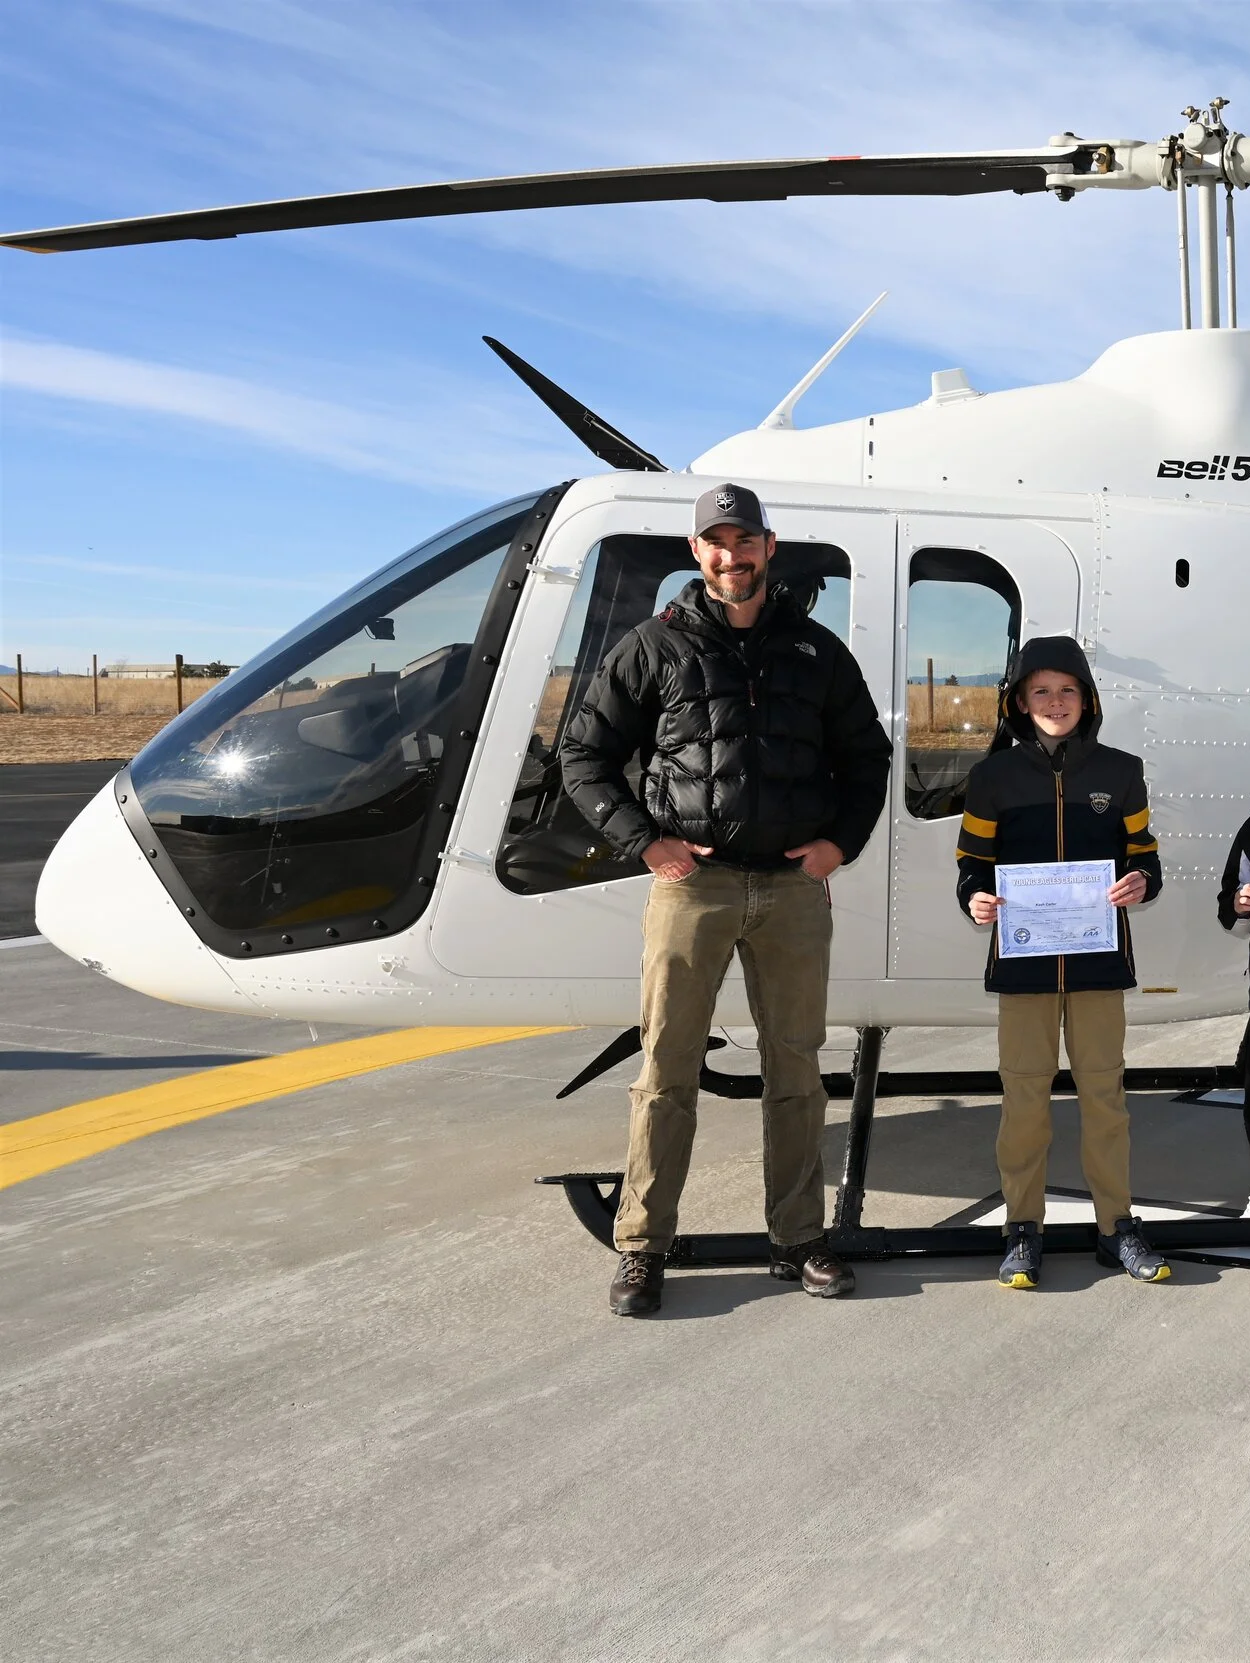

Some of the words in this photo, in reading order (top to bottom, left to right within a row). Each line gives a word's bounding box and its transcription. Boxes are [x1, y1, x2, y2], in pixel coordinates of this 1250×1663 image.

[1156, 455, 1231, 480] Bell
[1012, 878, 1035, 887] YOUNG
[1036, 876, 1062, 886] EAGLES
